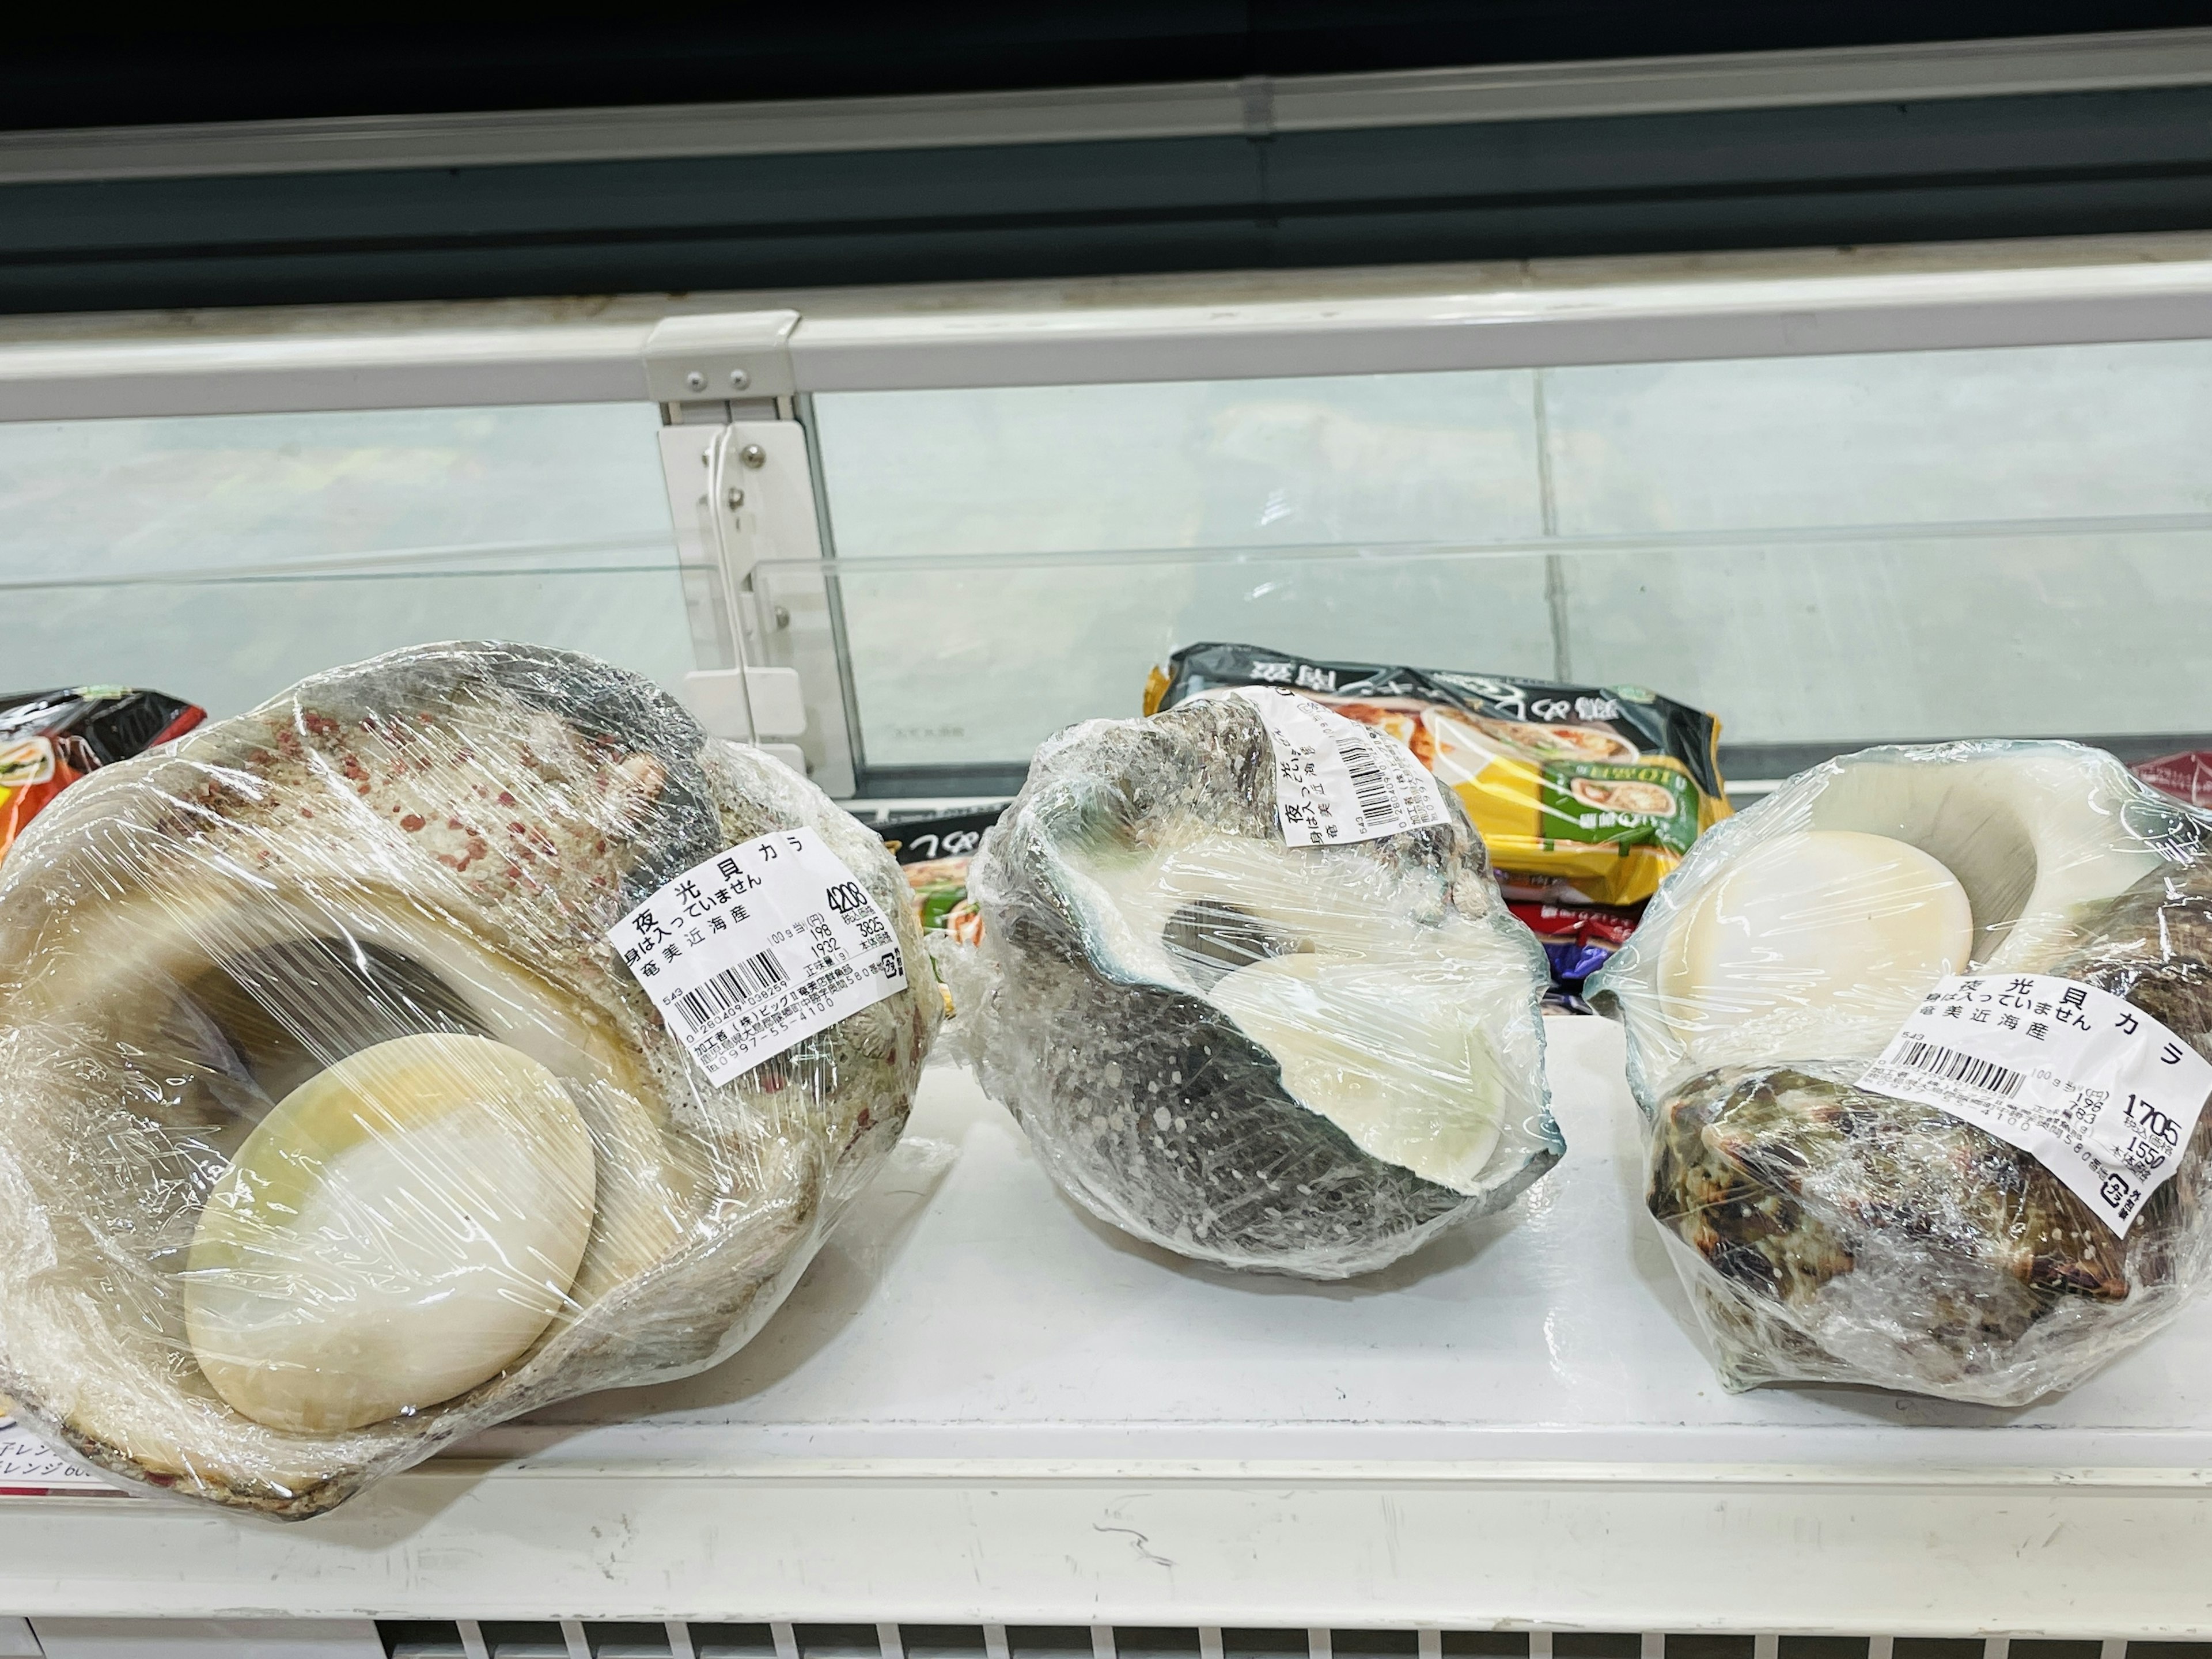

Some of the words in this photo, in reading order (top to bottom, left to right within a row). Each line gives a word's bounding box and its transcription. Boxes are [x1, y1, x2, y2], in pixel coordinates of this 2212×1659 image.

[1355, 816, 1368, 834] 543
[632, 836, 802, 935] 夜光貝カラ
[826, 882, 868, 914] 4208
[624, 874, 762, 967] 身は入っていません
[810, 923, 832, 941] 198
[856, 916, 884, 937] 3825
[640, 904, 750, 977] 奄美近海産
[811, 938, 840, 958] 1932
[662, 987, 683, 1006] 543
[686, 1034, 695, 1044] 0
[700, 1004, 743, 1035] 280409
[748, 980, 788, 1006] 038259
[1924, 993, 2092, 1032] 身は入っていません
[1919, 1005, 2050, 1041] 奄美近海産
[1959, 978, 2183, 1066] 夜光貝カラ
[694, 1029, 728, 1058] 加工者
[2069, 1100, 2096, 1124] 783
[2076, 1093, 2104, 1112] 198
[2123, 1094, 2182, 1146] 1705
[2127, 1137, 2165, 1169] 1550
